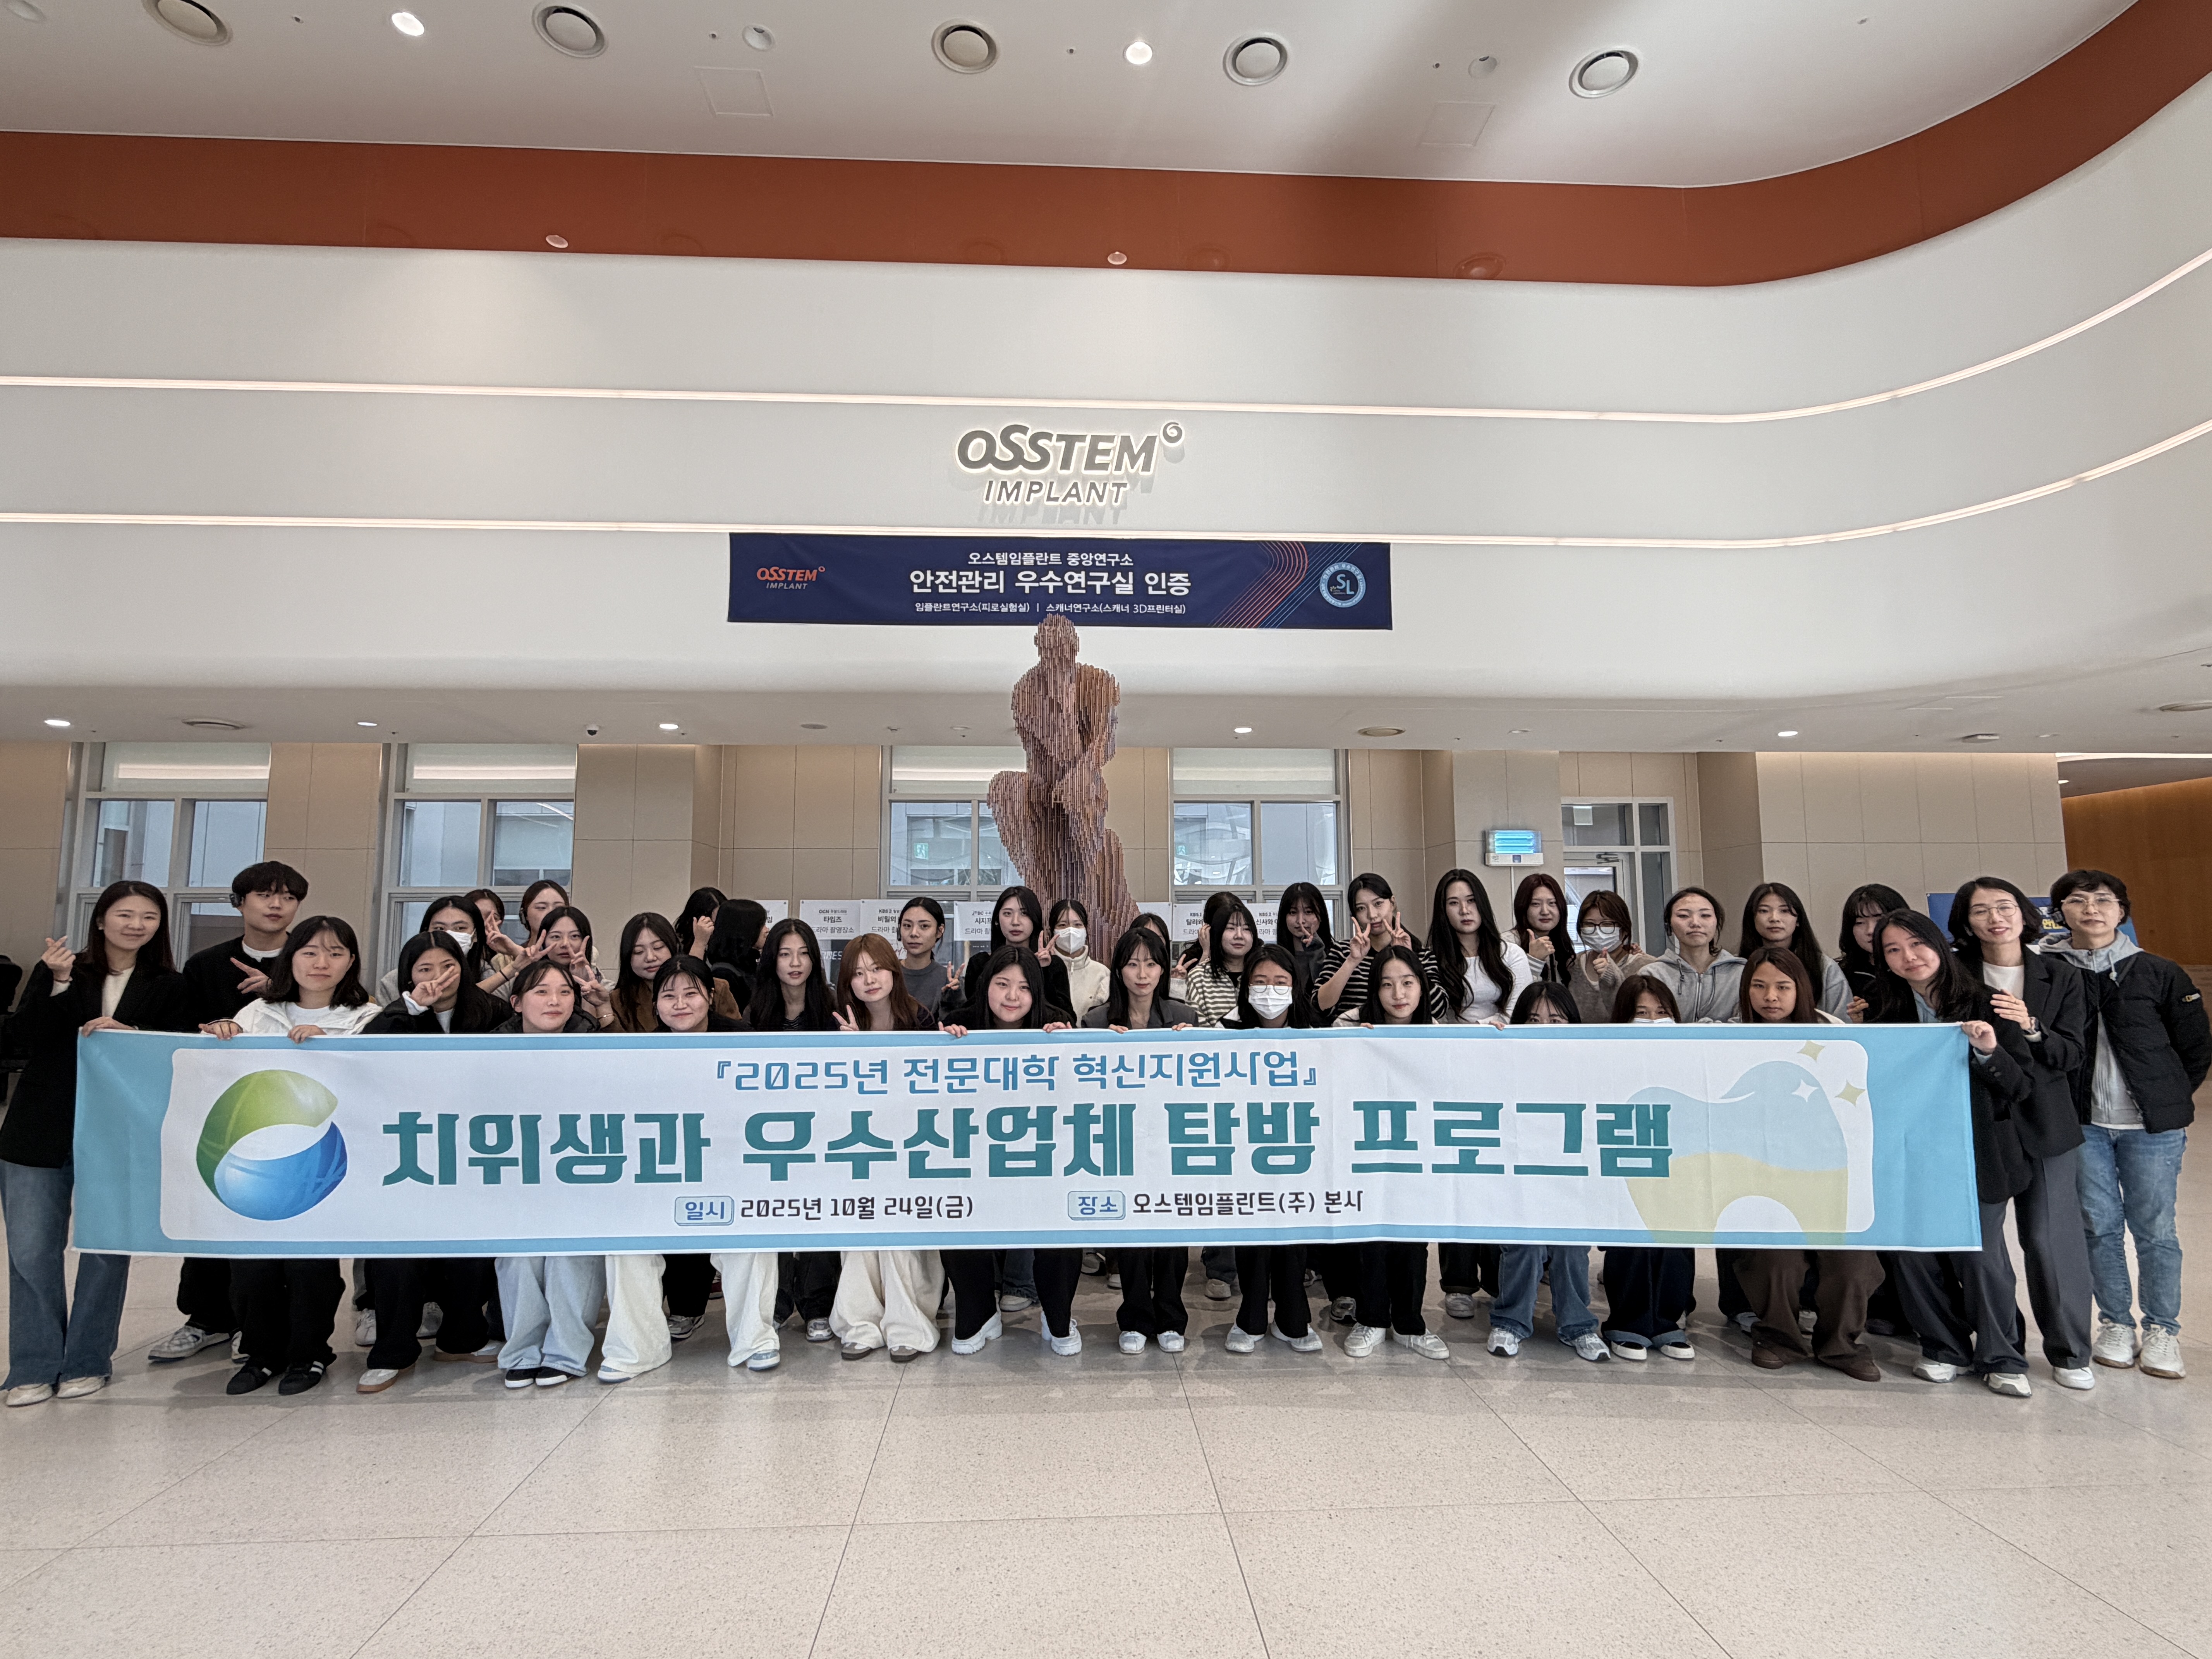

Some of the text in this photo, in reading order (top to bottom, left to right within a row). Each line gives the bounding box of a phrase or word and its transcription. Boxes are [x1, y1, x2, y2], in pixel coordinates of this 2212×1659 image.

[957, 424, 1158, 472] OSSTEM
[985, 480, 1128, 503] IMPLANT
[968, 552, 1133, 567] 오스템임플란트 중앙연구소
[756, 566, 817, 581] OSSTEM
[910, 570, 1191, 596] 안전관리 우수연구실 인증
[915, 602, 1030, 613] 임플란트연구소(피로실험실)
[1046, 603, 1129, 613] 스캐너연구소(스캐너
[1133, 604, 1186, 614] 3D프린터실)
[904, 1054, 1060, 1094] 전문대학
[382, 1101, 1673, 1186] 치위생과 우수산업체 탐방 프로그램
[685, 1195, 973, 1221] 일시 2025년 10월 24일(금)
[1078, 1190, 1363, 1216] 장소 오스템임플란트(주) 본사
